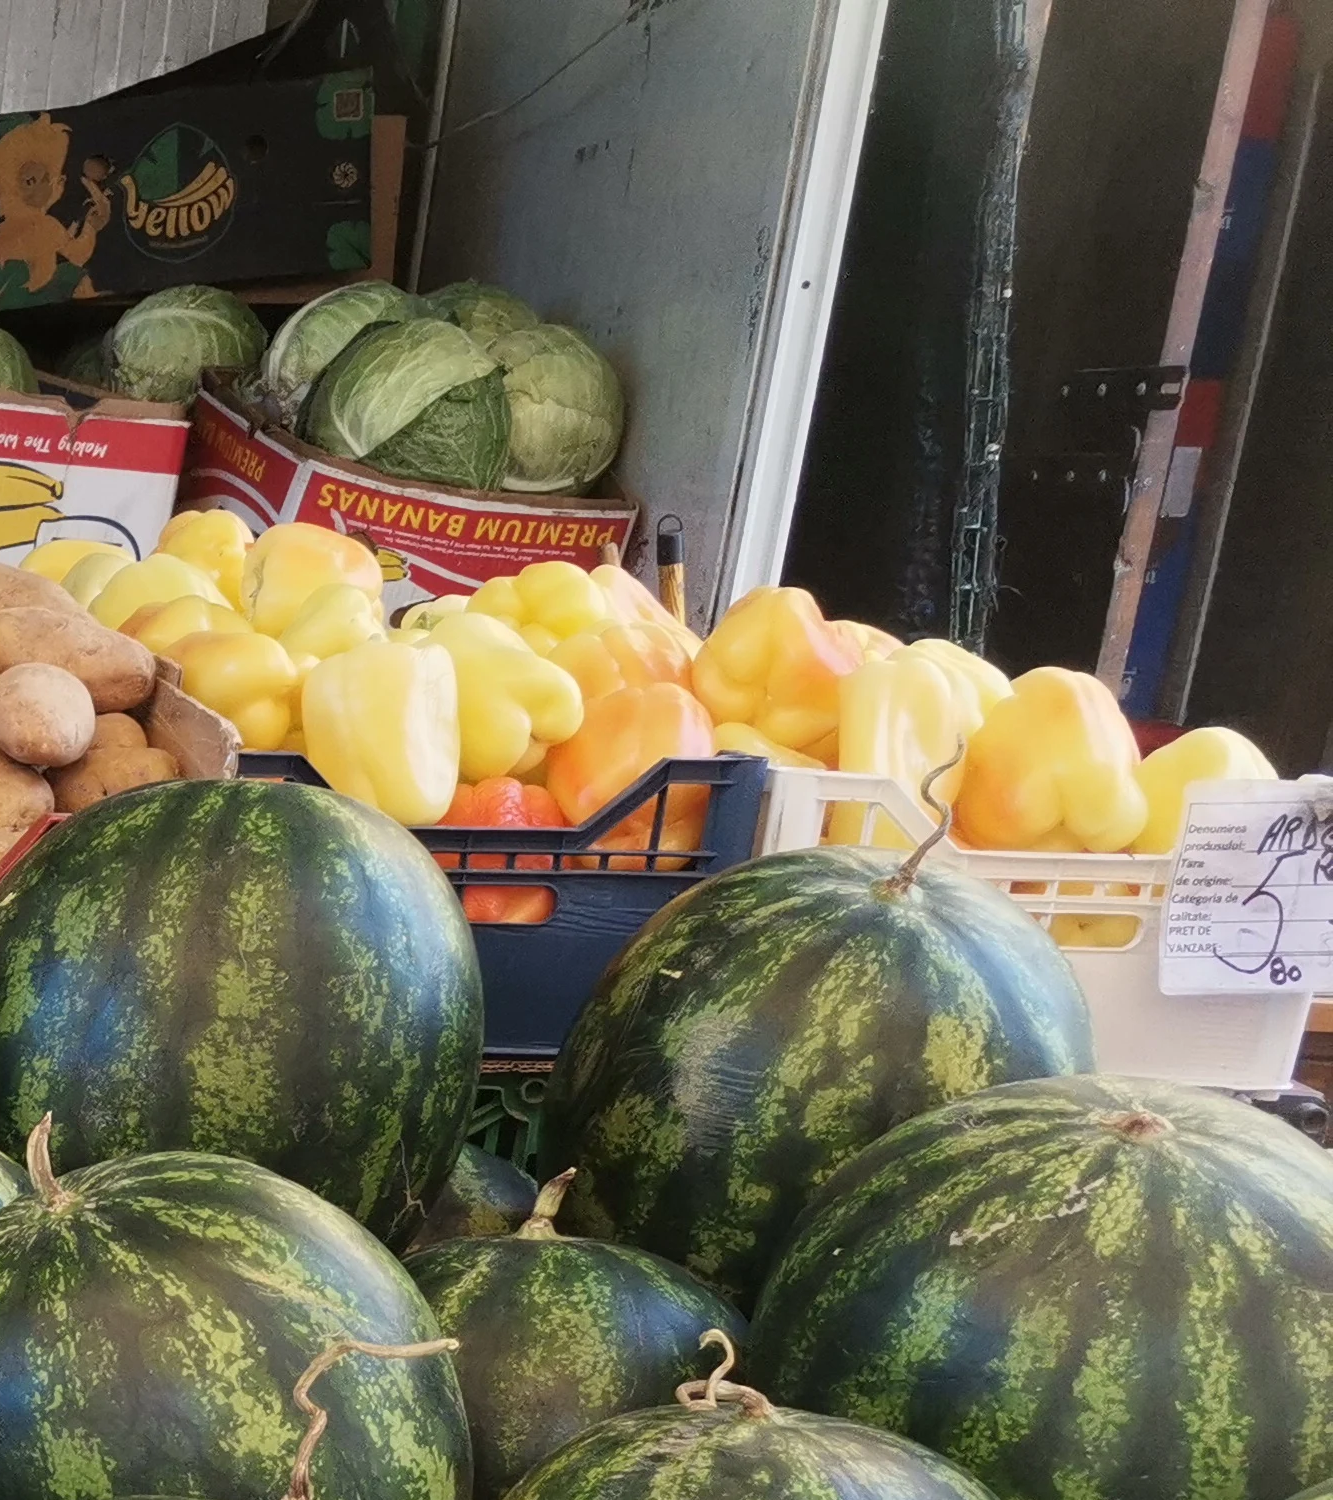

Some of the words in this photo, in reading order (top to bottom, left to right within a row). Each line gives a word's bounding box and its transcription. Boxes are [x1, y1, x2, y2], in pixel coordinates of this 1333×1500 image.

[121, 174, 235, 239] yellow
[24, 436, 51, 454] The
[58, 433, 109, 458] Making
[317, 483, 467, 538] BANANAS
[474, 517, 618, 548] PREMIUM
[1188, 824, 1247, 834] Denumirea
[1175, 876, 1190, 886] de
[1171, 893, 1222, 906] Categoria
[1224, 893, 1238, 904] de
[1169, 911, 1212, 921] calitate:
[1168, 925, 1195, 935] PRET
[1197, 925, 1212, 935] DE
